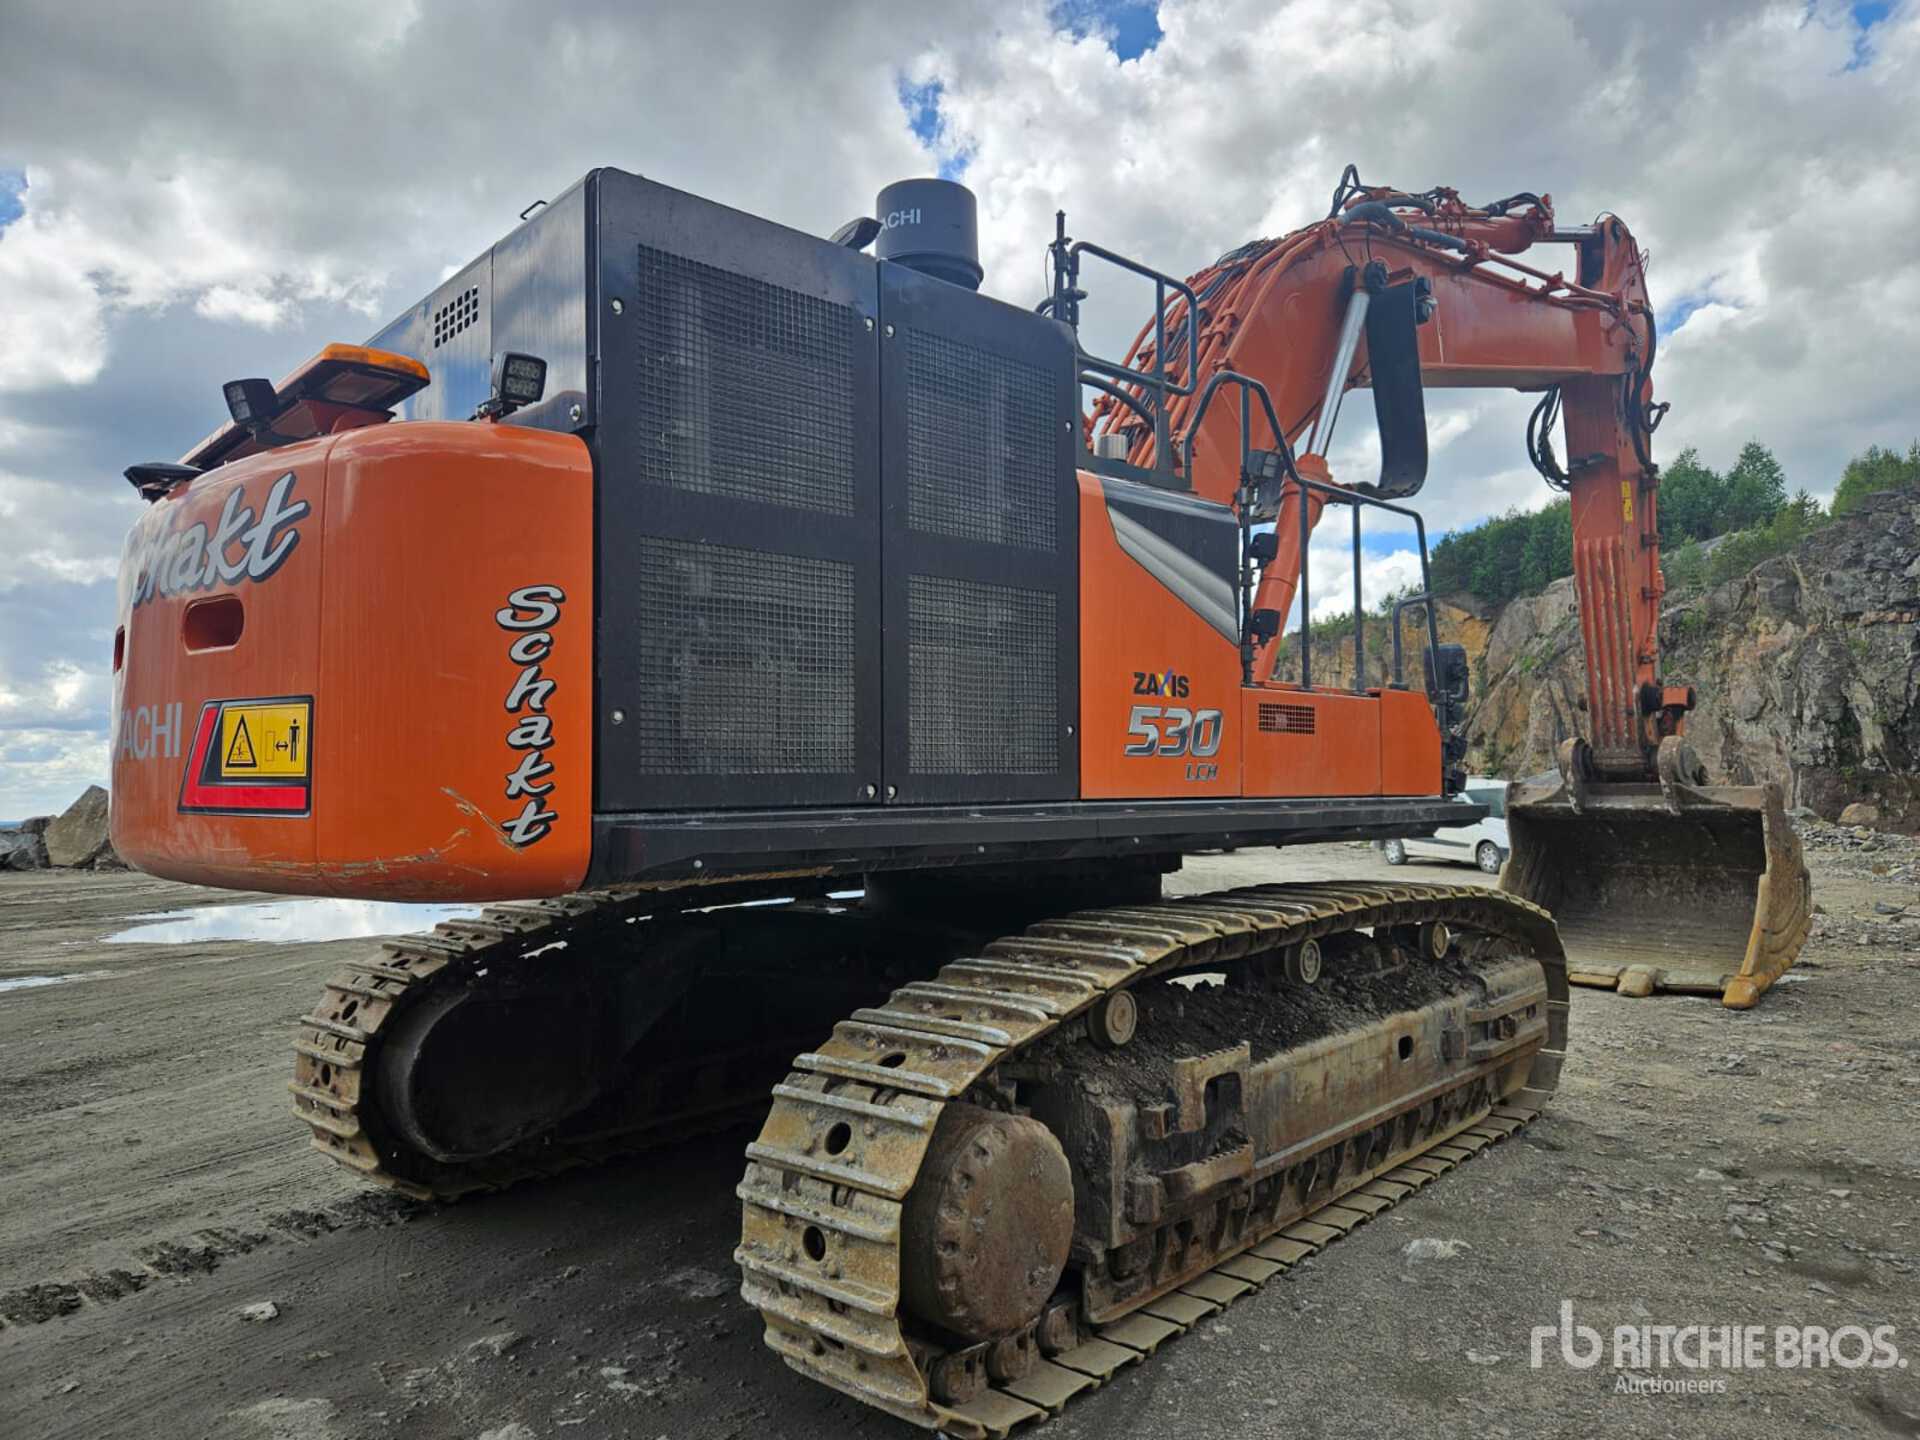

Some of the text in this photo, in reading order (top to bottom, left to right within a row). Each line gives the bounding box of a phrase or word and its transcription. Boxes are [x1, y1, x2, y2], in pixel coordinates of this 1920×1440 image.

[1133, 667, 1190, 698] ZAXIS
[117, 702, 183, 760] ACHI
[495, 584, 567, 848] Schakt
[1123, 705, 1224, 757] 530
